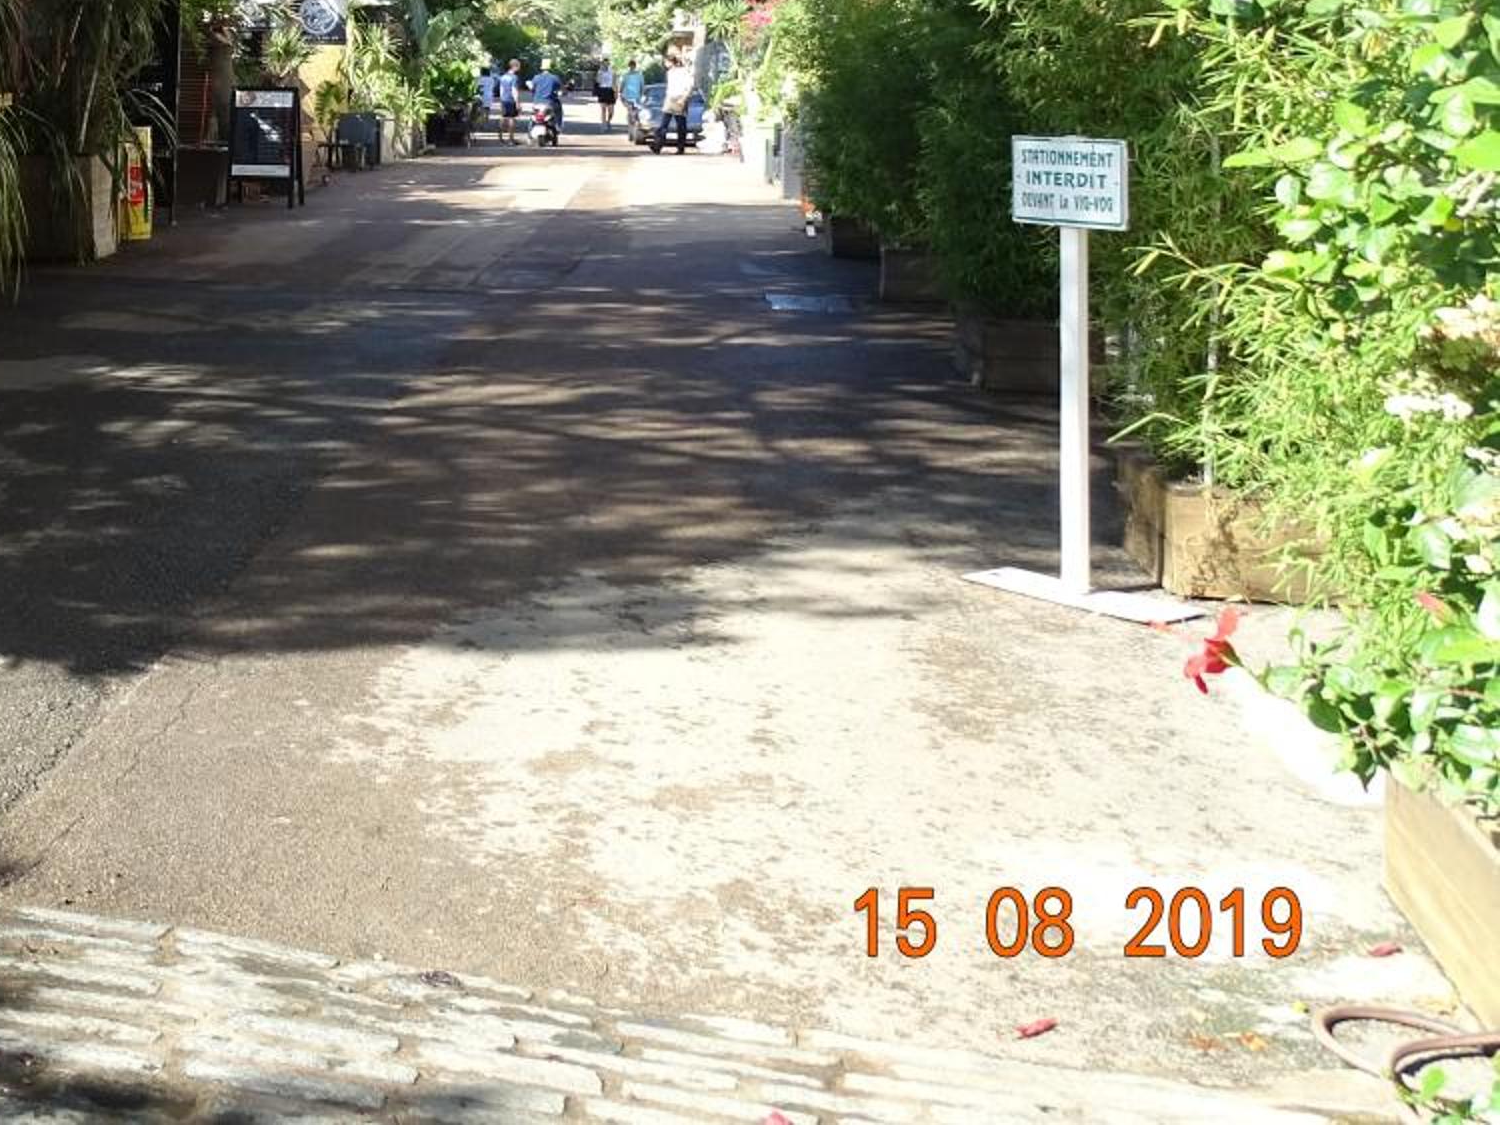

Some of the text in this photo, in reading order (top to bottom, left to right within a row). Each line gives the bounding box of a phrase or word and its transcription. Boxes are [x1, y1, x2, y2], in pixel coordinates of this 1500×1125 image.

[1021, 148, 1114, 168] STATIONNEMENT
[1026, 170, 1108, 190] INTERDIT
[1021, 191, 1055, 210] DEVANT
